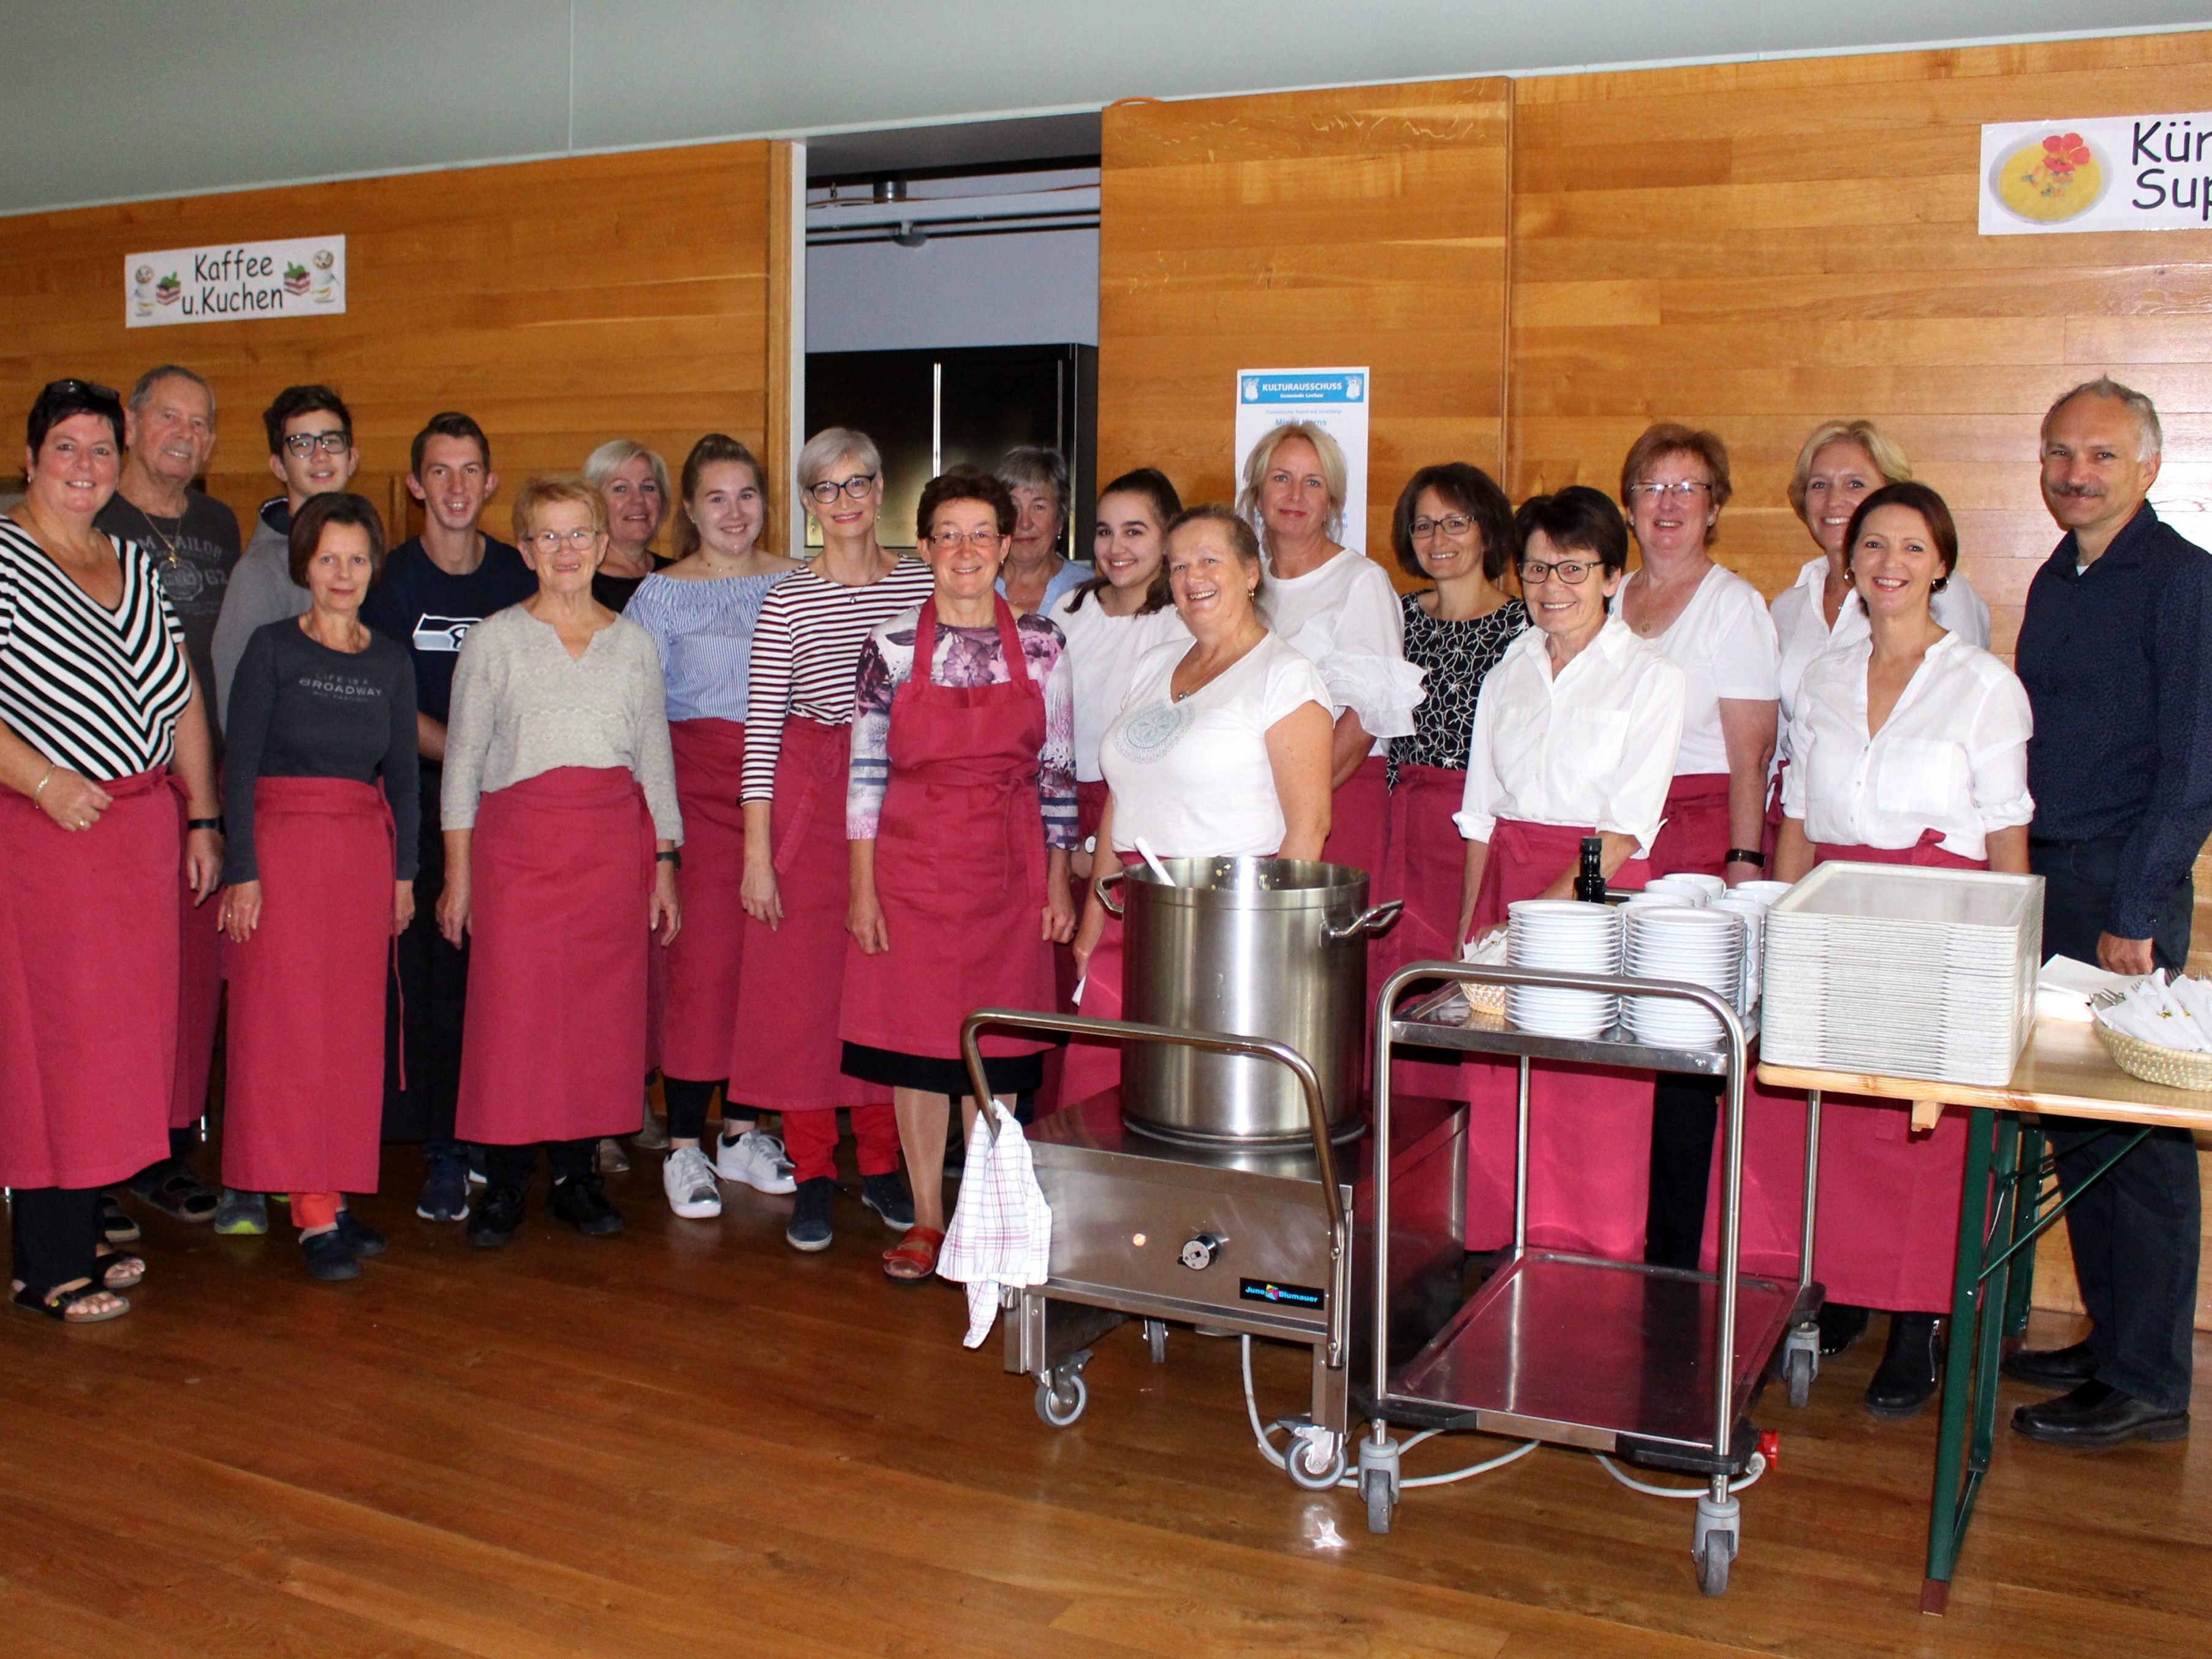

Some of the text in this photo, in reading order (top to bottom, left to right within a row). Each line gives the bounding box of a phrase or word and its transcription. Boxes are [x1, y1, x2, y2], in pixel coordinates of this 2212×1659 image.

[194, 249, 273, 283] Kaffee
[181, 282, 284, 315] u.Kuchen
[1262, 382, 1343, 391] KULTURAUSSCHUSS
[1245, 1286, 1319, 1303] Juno Blumauer
